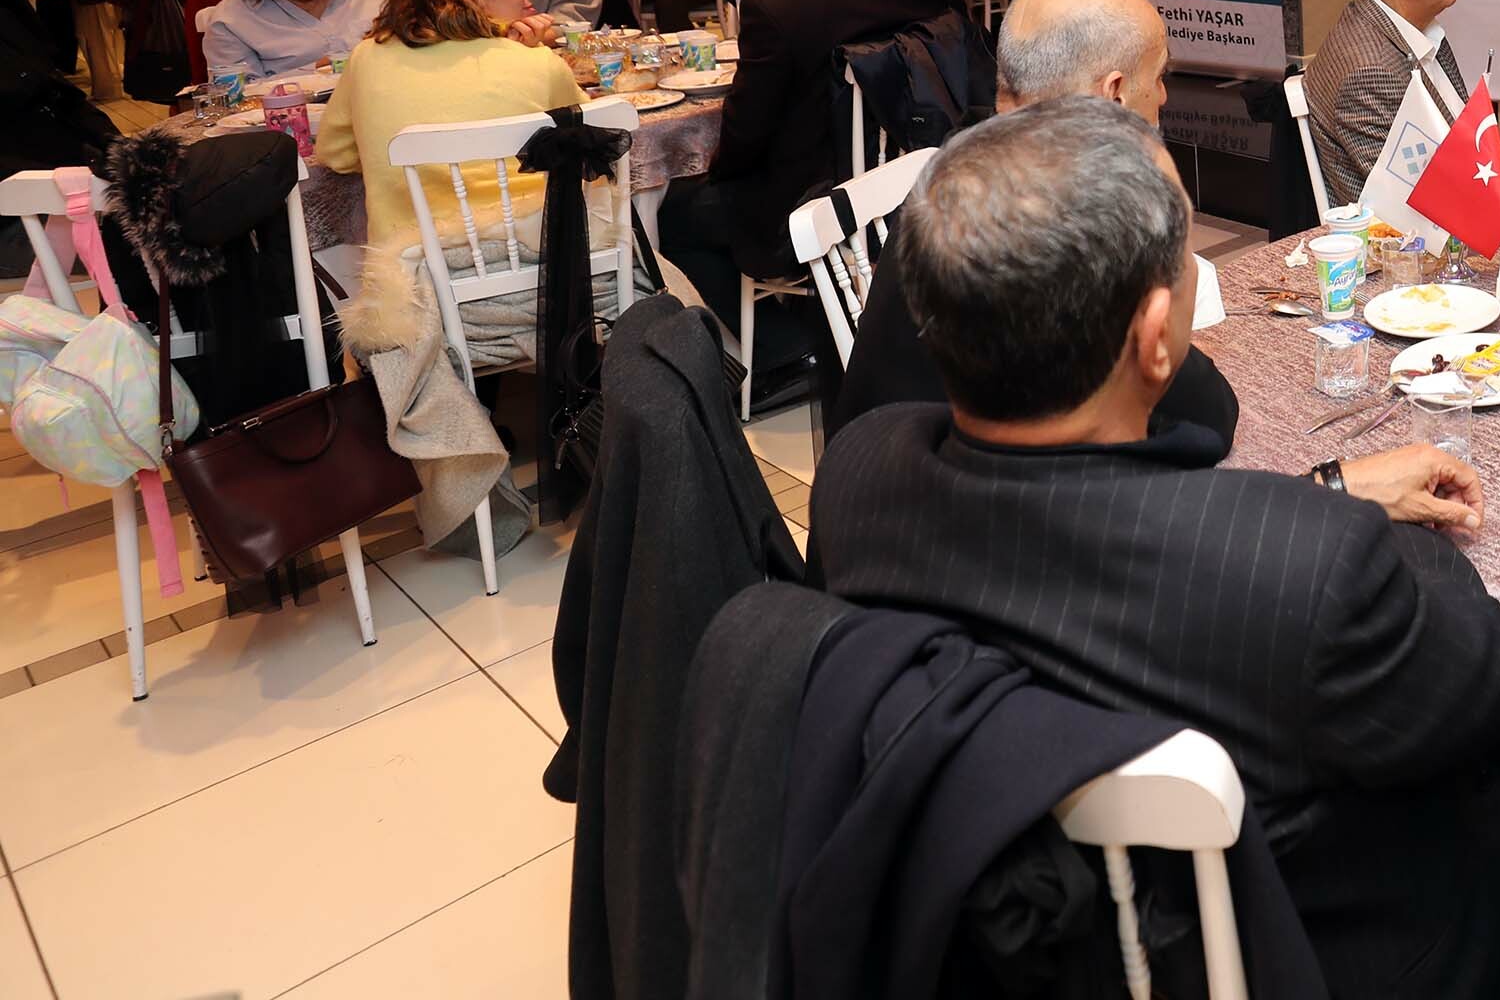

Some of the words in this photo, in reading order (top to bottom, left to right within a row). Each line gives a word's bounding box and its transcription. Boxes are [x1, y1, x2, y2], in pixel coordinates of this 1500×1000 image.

[1157, 6, 1193, 22] Fethi
[1196, 9, 1244, 28] YAŞAR
[1166, 26, 1204, 42] lediye
[1207, 30, 1255, 46] Başkanı
